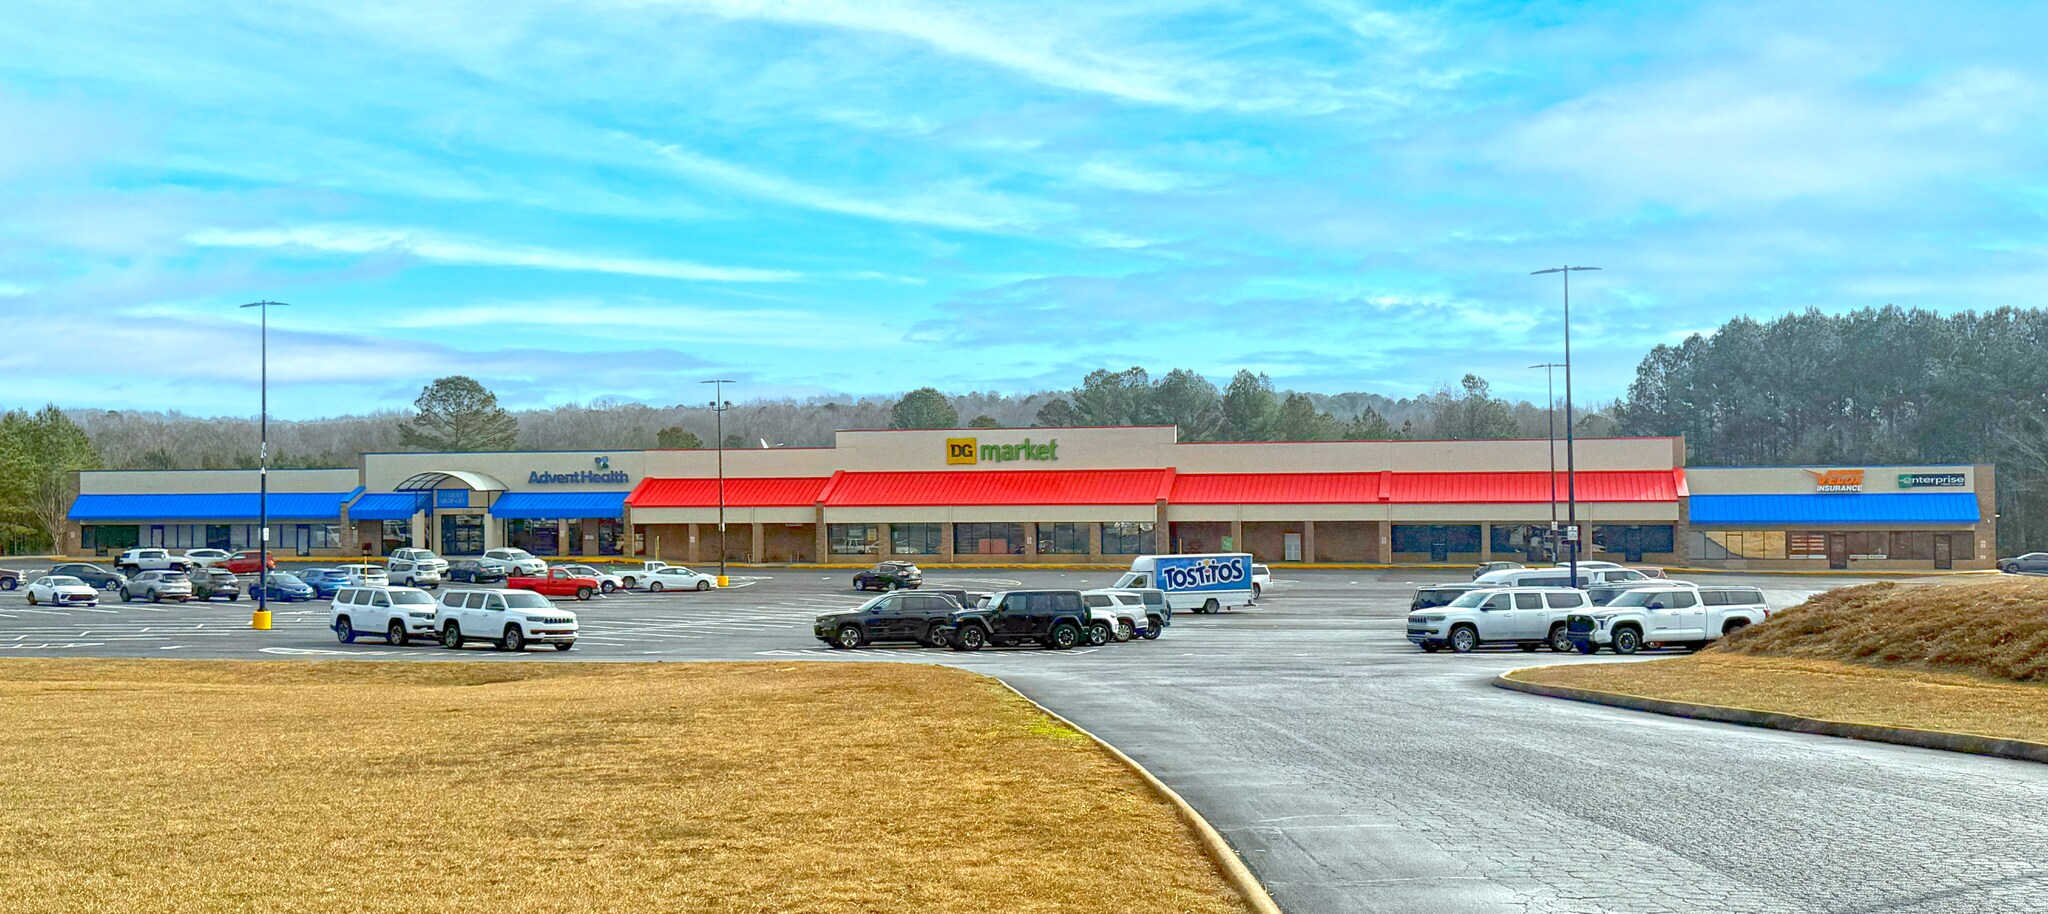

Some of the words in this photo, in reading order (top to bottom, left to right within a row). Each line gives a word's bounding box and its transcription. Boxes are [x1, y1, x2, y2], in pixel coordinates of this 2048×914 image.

[950, 443, 973, 458] DG
[980, 438, 1058, 463] market
[1808, 469, 1865, 485] VELOX
[1901, 475, 1965, 485] enterprise
[1816, 484, 1863, 492] INSURANCE
